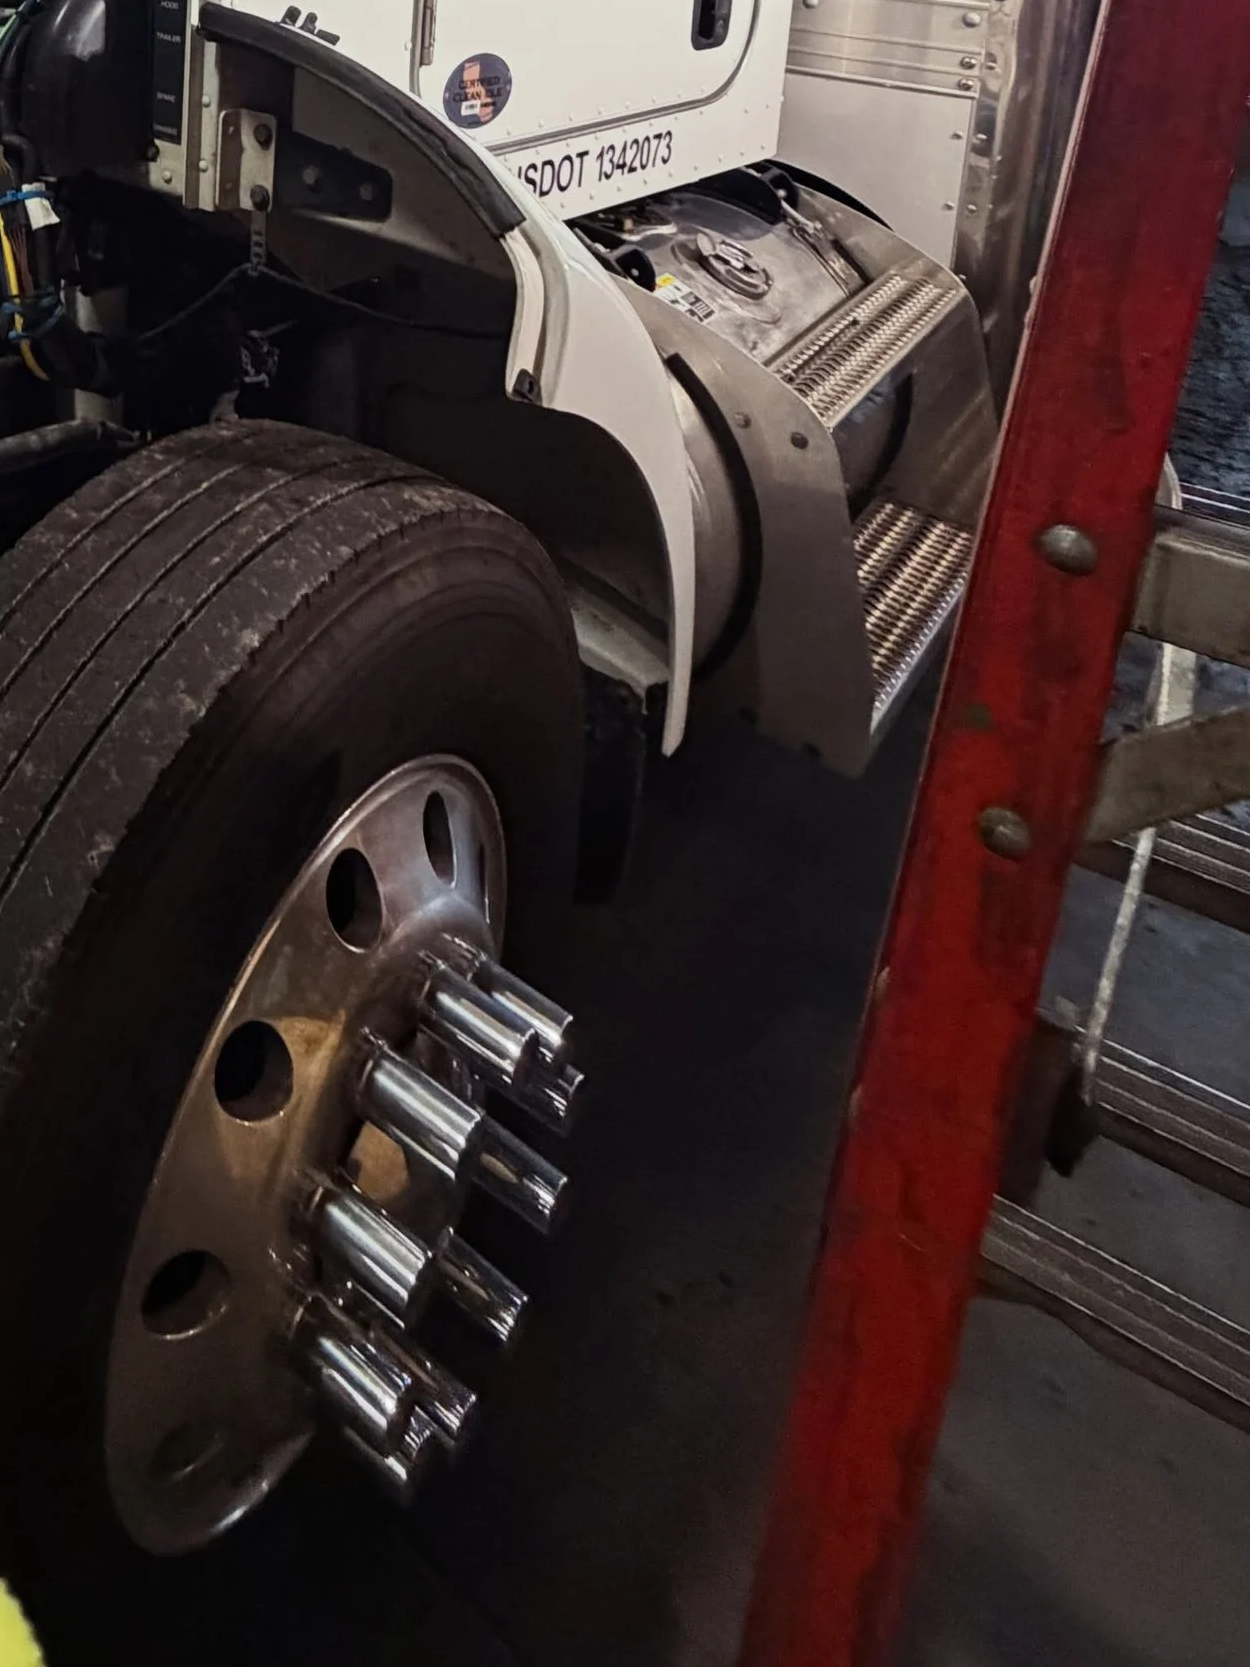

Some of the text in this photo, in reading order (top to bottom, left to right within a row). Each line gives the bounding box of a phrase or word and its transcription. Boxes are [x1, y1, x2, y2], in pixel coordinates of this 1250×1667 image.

[160, 0, 179, 10] HOOD
[156, 32, 182, 44] TRAILER
[595, 130, 673, 182] 1342073
